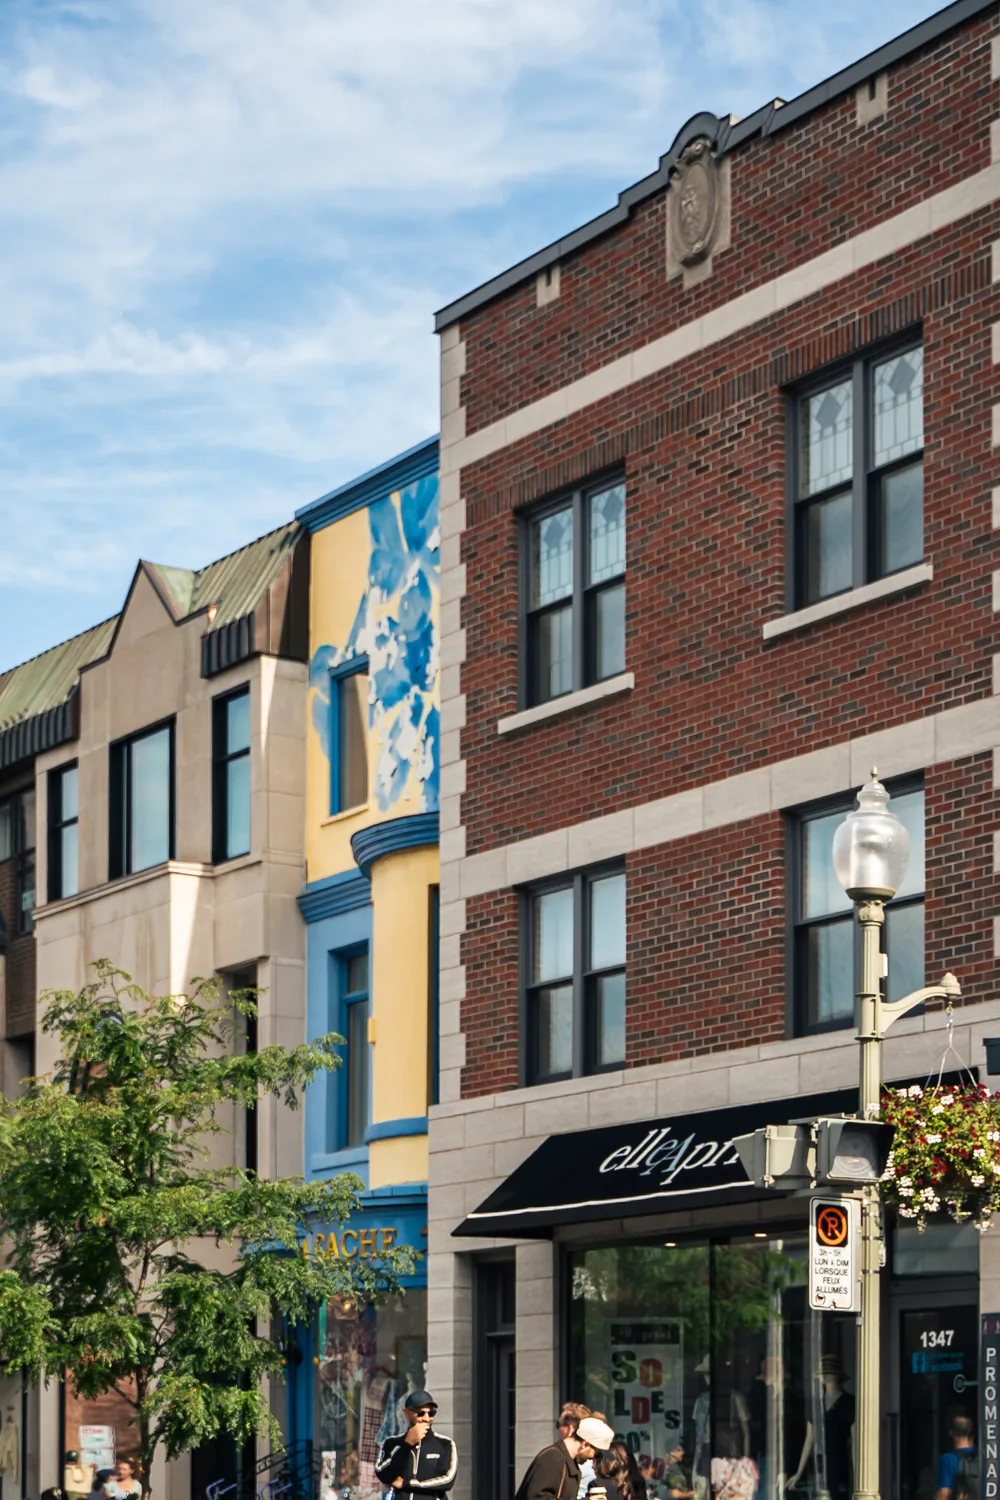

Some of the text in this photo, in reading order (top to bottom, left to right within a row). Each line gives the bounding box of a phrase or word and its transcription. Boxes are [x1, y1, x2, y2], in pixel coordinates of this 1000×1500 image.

[815, 1267, 849, 1277] LORSQUE
[823, 1277, 840, 1285] FEUX
[920, 1330, 954, 1348] 1347
